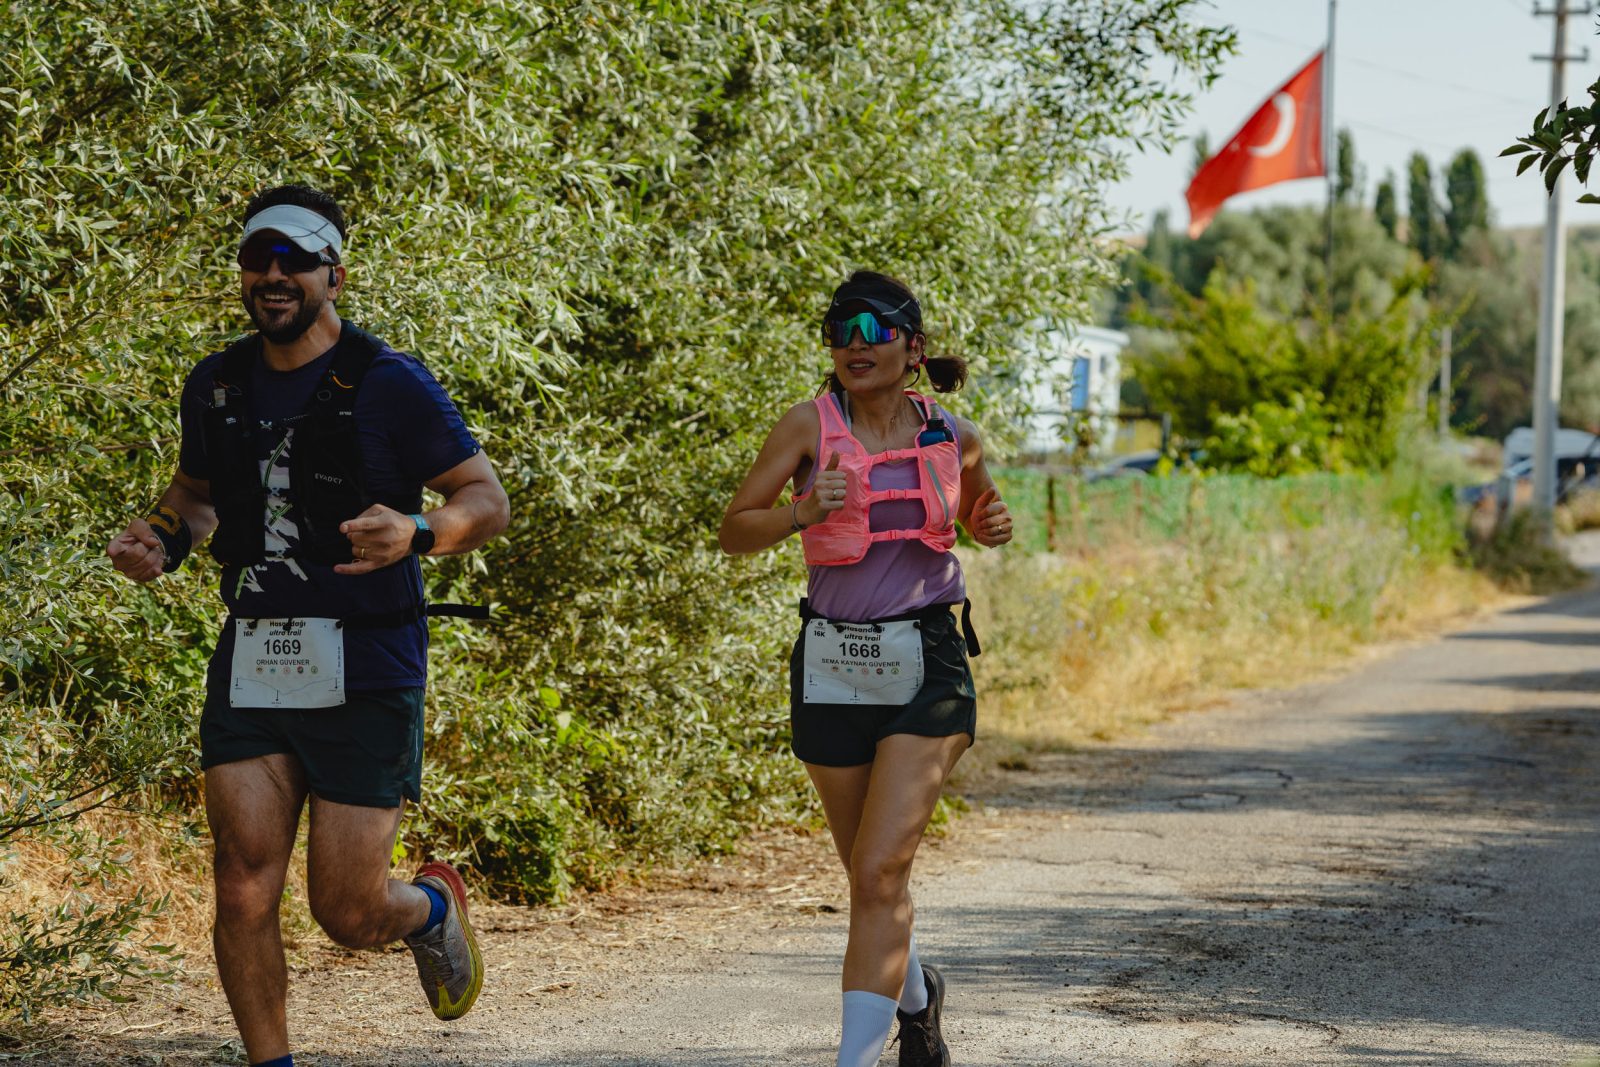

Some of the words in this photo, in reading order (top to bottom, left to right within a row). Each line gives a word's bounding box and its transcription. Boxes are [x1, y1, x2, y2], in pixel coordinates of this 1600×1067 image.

[264, 639, 302, 655] 1669
[839, 641, 881, 659] 1668
[840, 659, 868, 667] KAYNAK
